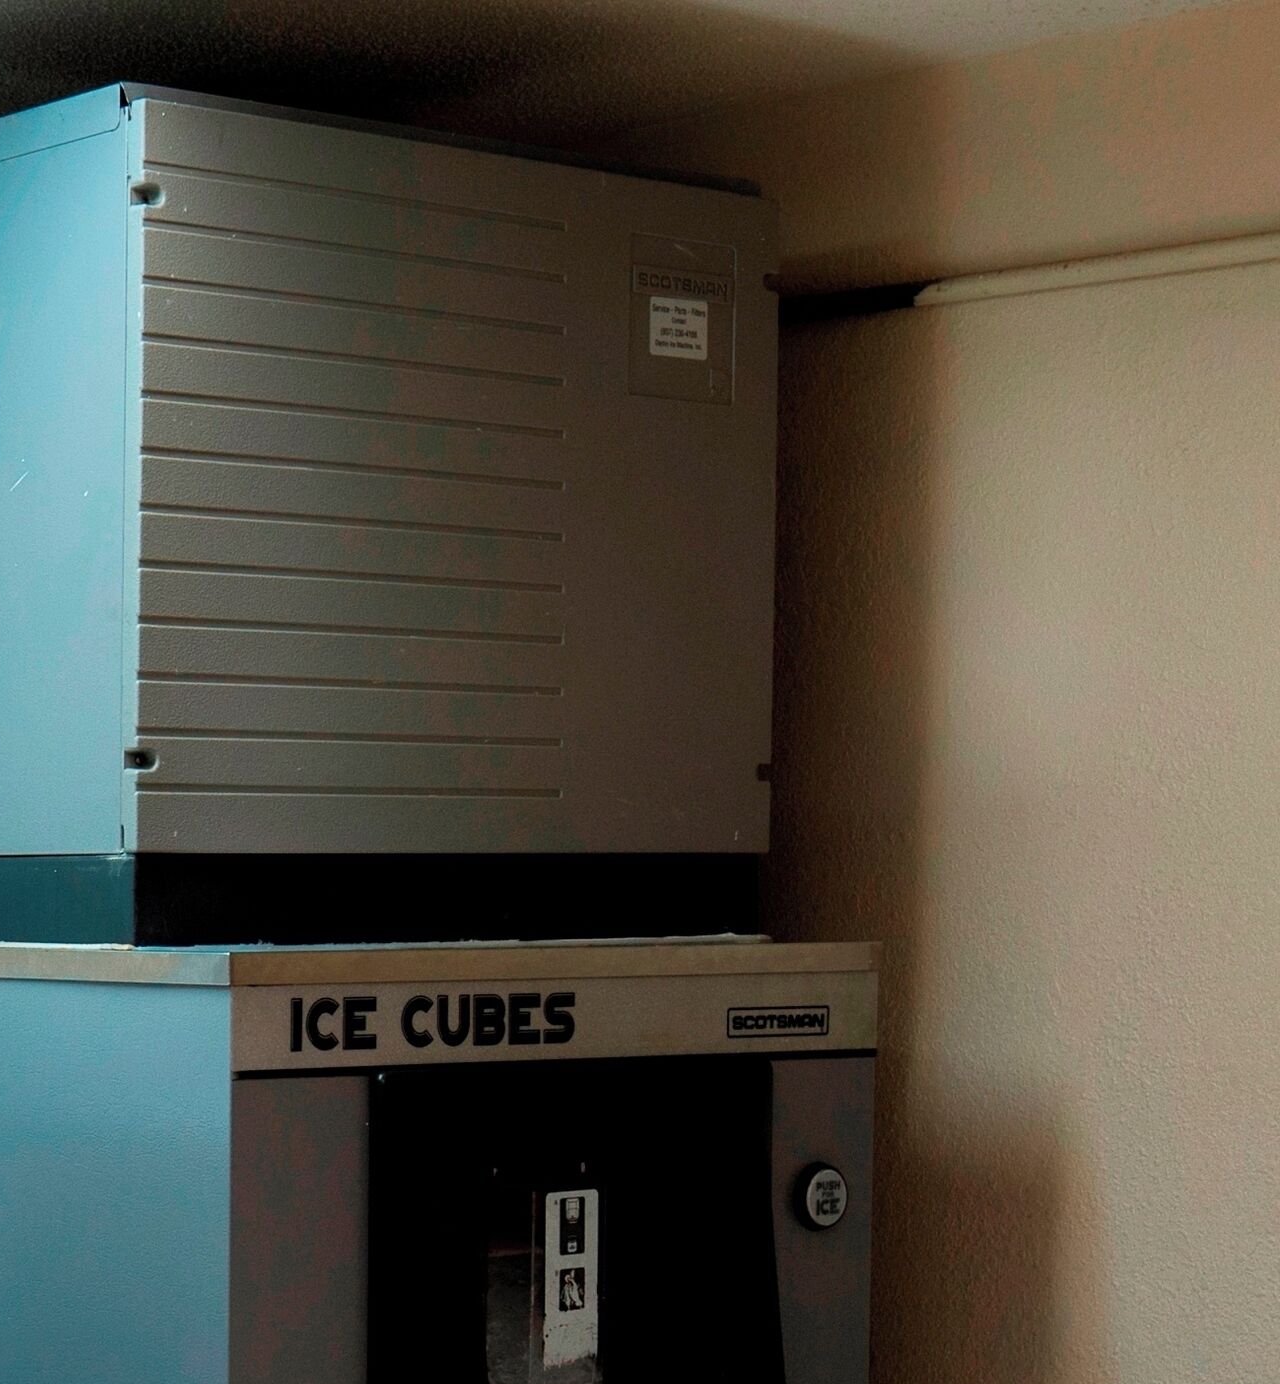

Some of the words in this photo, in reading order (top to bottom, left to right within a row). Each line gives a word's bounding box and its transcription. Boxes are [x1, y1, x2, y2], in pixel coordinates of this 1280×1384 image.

[638, 272, 728, 301] SCOTSMAN
[290, 996, 377, 1052] ICE
[400, 992, 575, 1048] CUBES
[732, 1013, 825, 1030] SCOTSMAN
[816, 1180, 841, 1191] PUSH
[816, 1198, 841, 1216] ICE
